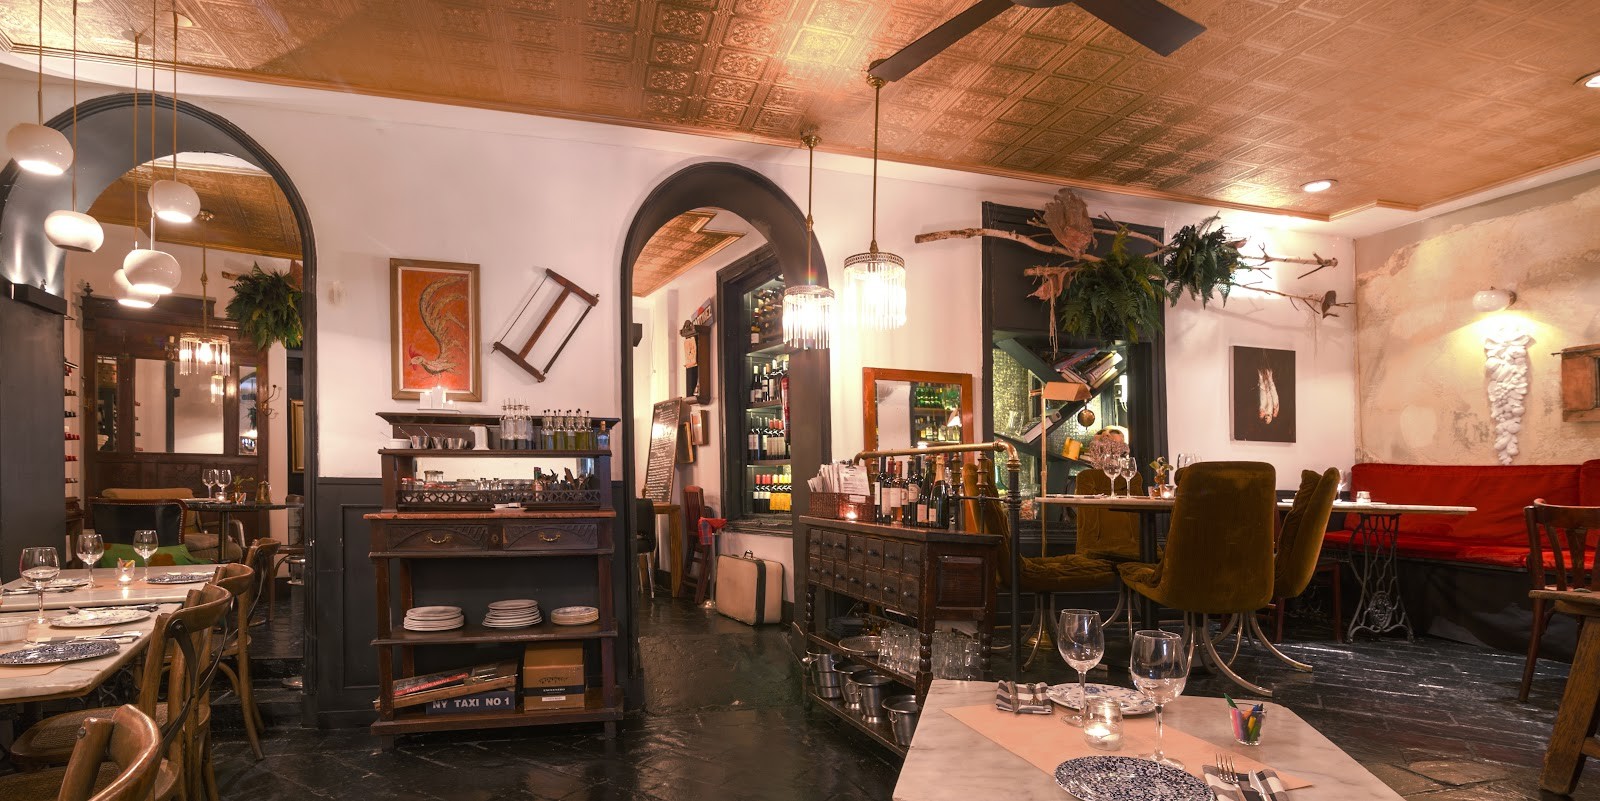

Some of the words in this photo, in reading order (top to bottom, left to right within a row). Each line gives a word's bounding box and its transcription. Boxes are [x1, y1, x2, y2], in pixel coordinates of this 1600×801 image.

[432, 700, 448, 709] NY
[454, 698, 479, 708] TAXI
[485, 697, 501, 707] NO
[504, 697, 510, 705] 1
